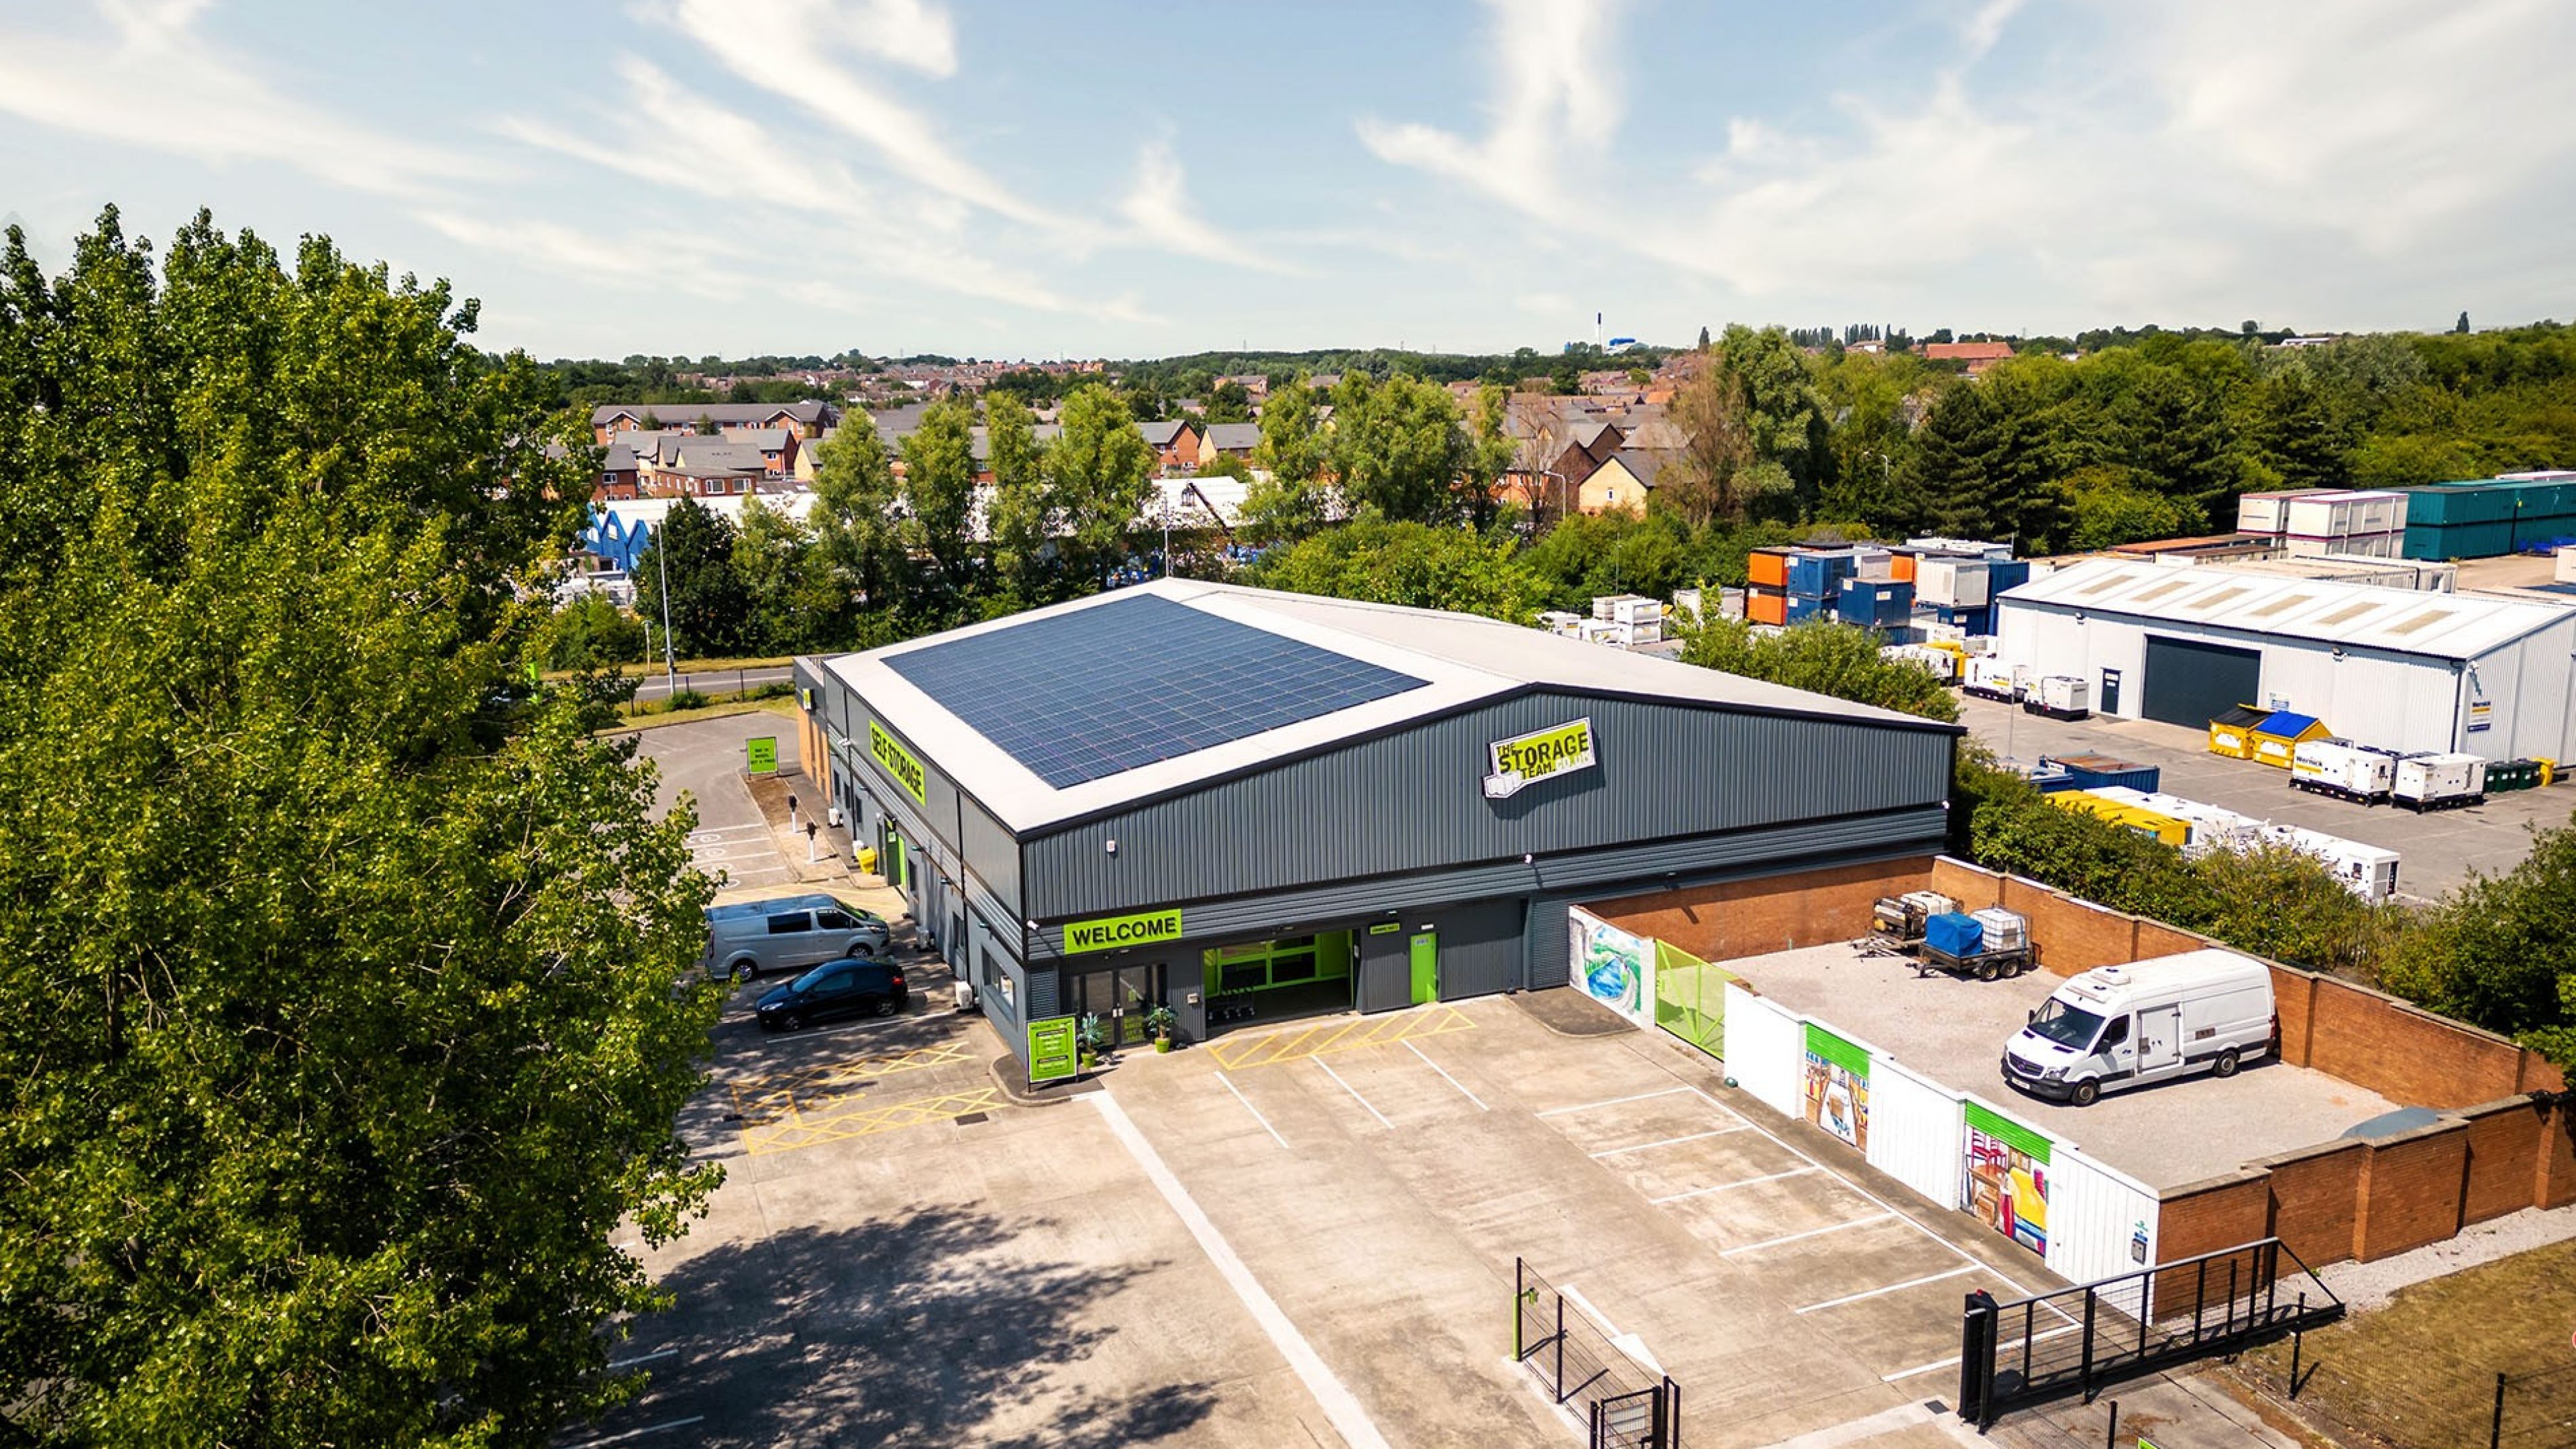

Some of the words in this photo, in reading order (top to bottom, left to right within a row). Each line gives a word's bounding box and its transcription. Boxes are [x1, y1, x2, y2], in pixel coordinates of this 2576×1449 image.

[871, 728, 887, 761] SELF
[888, 743, 922, 798] STORAGE
[1497, 742, 1516, 757] THE
[1499, 732, 1589, 774] STORAGE
[1073, 916, 1175, 947] WELCOME
